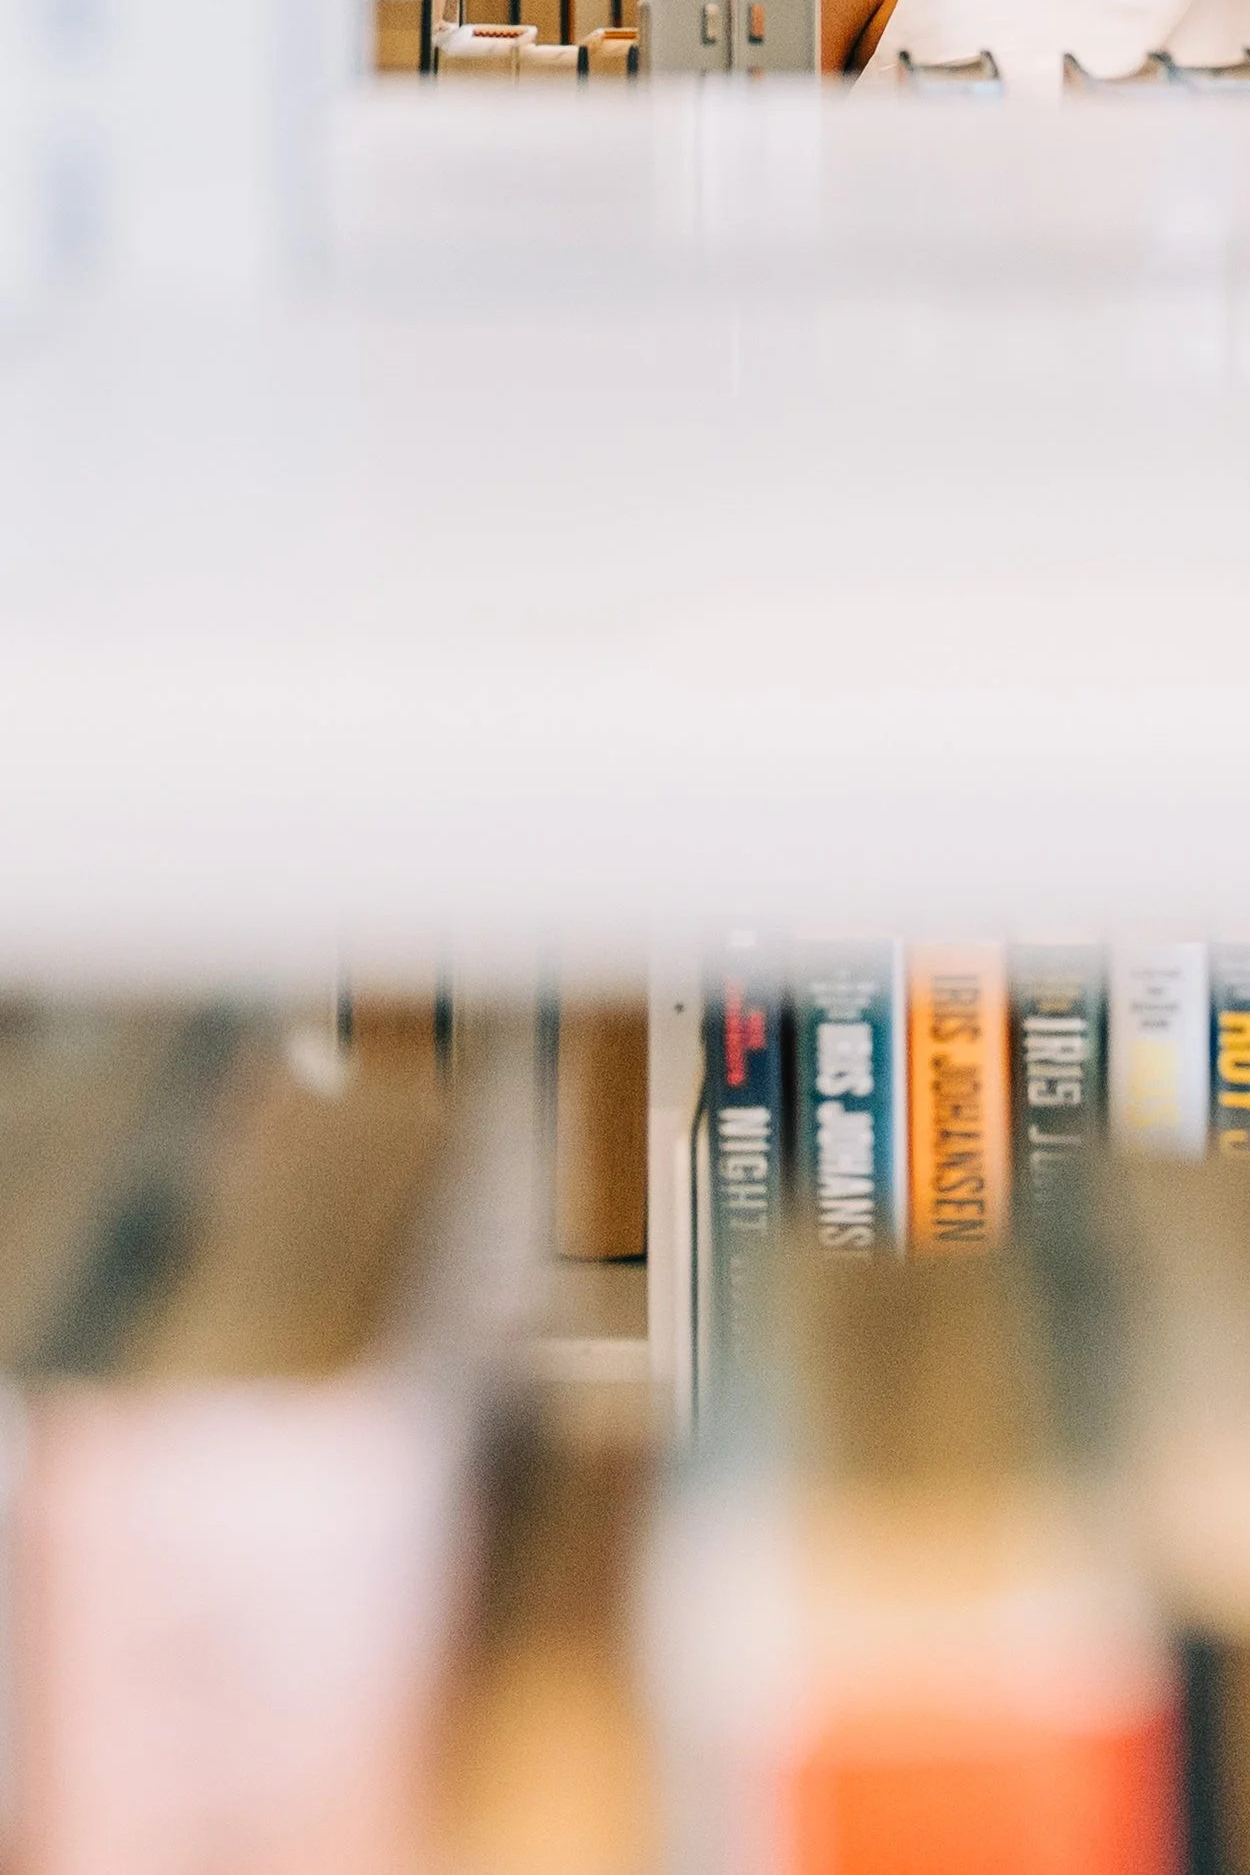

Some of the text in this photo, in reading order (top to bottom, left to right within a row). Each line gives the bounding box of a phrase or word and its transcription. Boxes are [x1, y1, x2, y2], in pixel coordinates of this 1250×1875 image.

[930, 973, 985, 1244] IRIS JOHANSEN
[1021, 1016, 1089, 1107] IRIS
[815, 1099, 874, 1260] JOHANS
